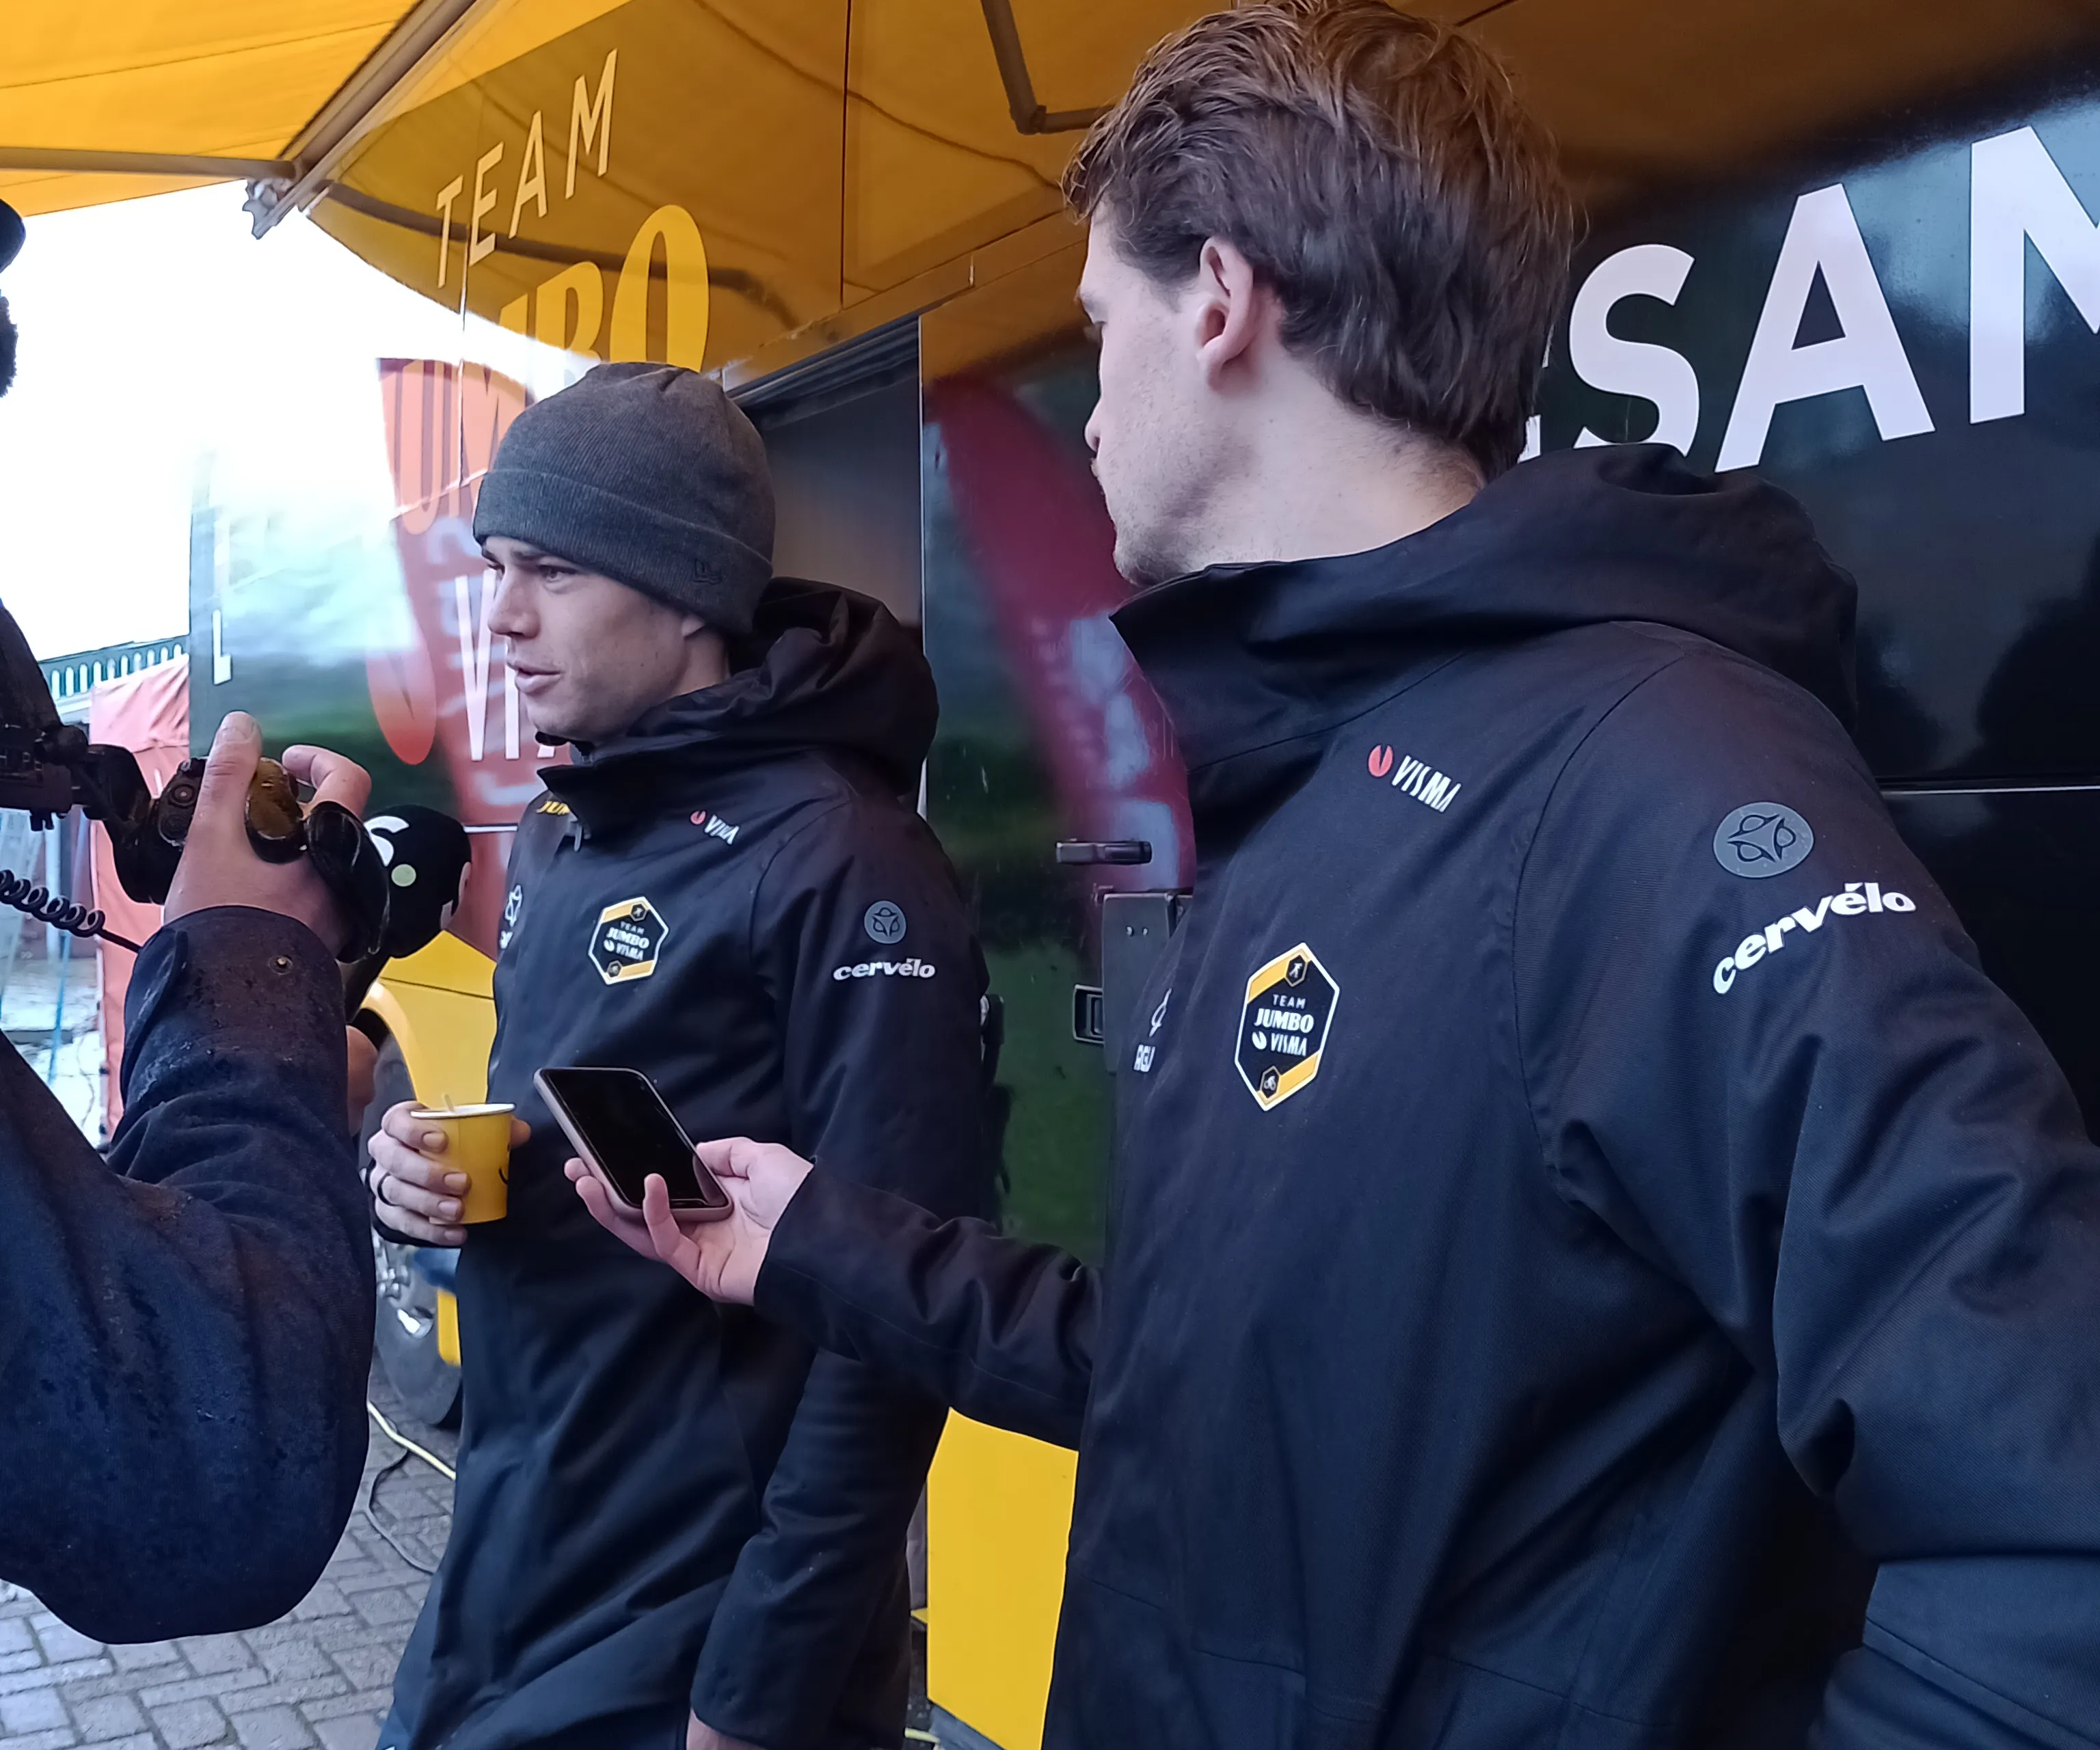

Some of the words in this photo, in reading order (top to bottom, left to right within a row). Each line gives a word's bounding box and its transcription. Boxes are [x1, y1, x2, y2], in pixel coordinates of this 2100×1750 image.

[436, 48, 617, 288] TEAM
[1518, 125, 2100, 473] SAM
[1391, 755, 1462, 813] VISMA
[705, 814, 740, 845] VIA
[606, 926, 649, 949] JUMBO
[620, 921, 645, 935] TEAM
[1712, 882, 1916, 995] cervélo
[833, 958, 936, 981] cervélo
[1273, 993, 1306, 1009] TEAM
[1253, 1008, 1314, 1034] JUMBO
[1270, 1032, 1308, 1057] VISMA
